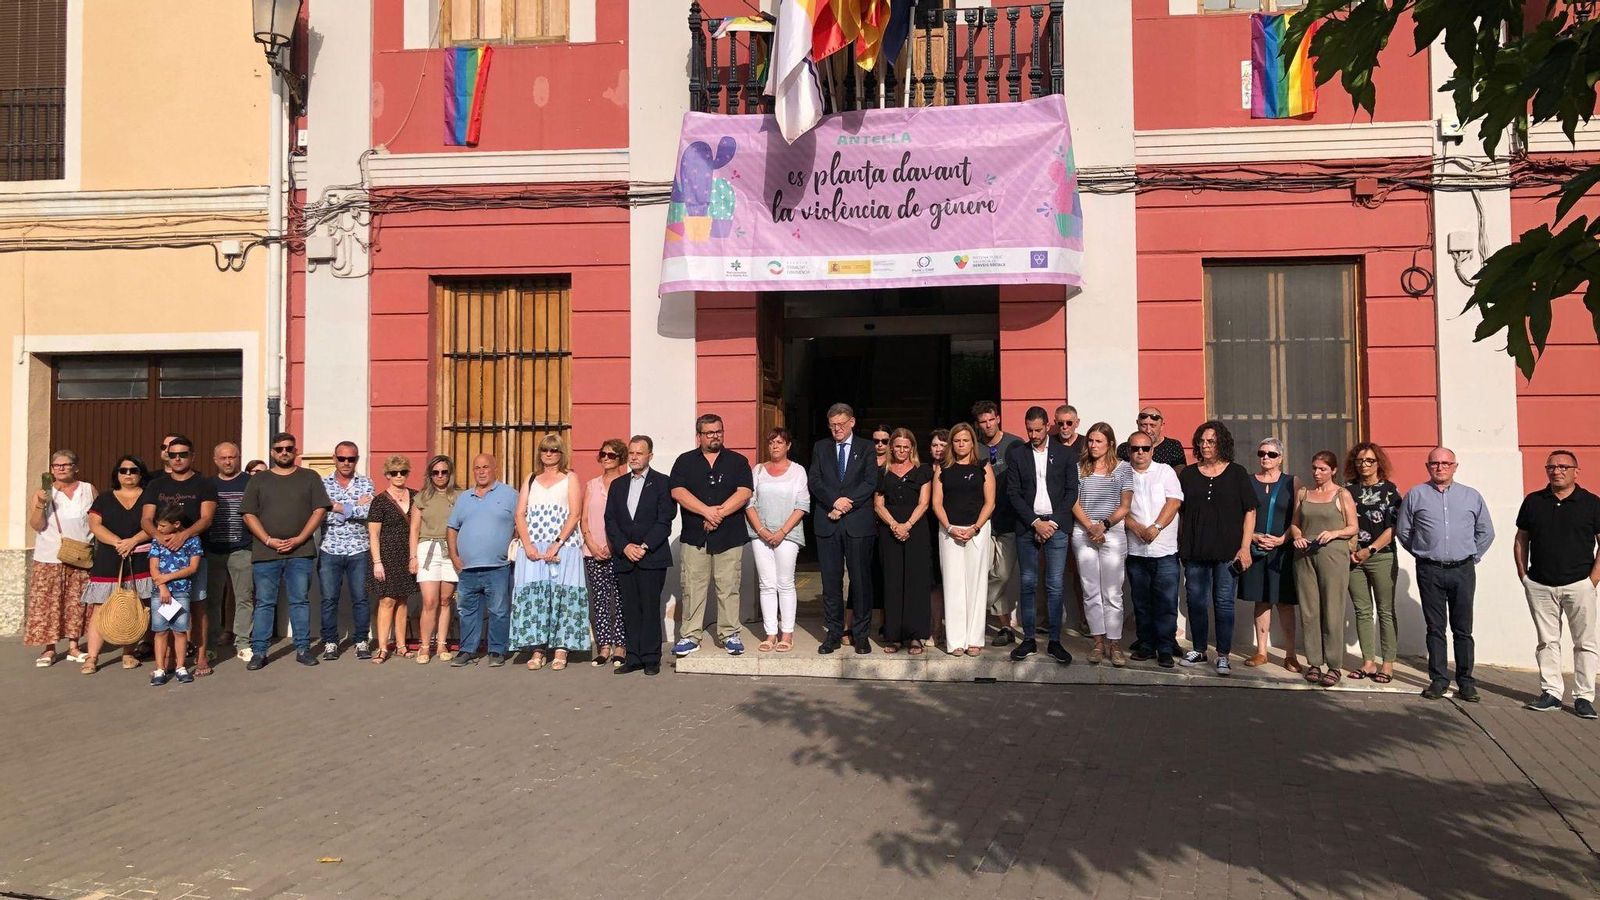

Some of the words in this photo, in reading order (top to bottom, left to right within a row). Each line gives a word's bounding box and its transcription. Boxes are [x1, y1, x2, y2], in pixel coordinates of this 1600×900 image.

[837, 132, 912, 145] ANTELLA
[788, 170, 806, 187] es
[814, 151, 887, 195] planta
[893, 151, 972, 186] davant
[772, 189, 795, 223] la
[801, 187, 892, 222] violència
[898, 187, 922, 218] de
[929, 198, 998, 229] gènere
